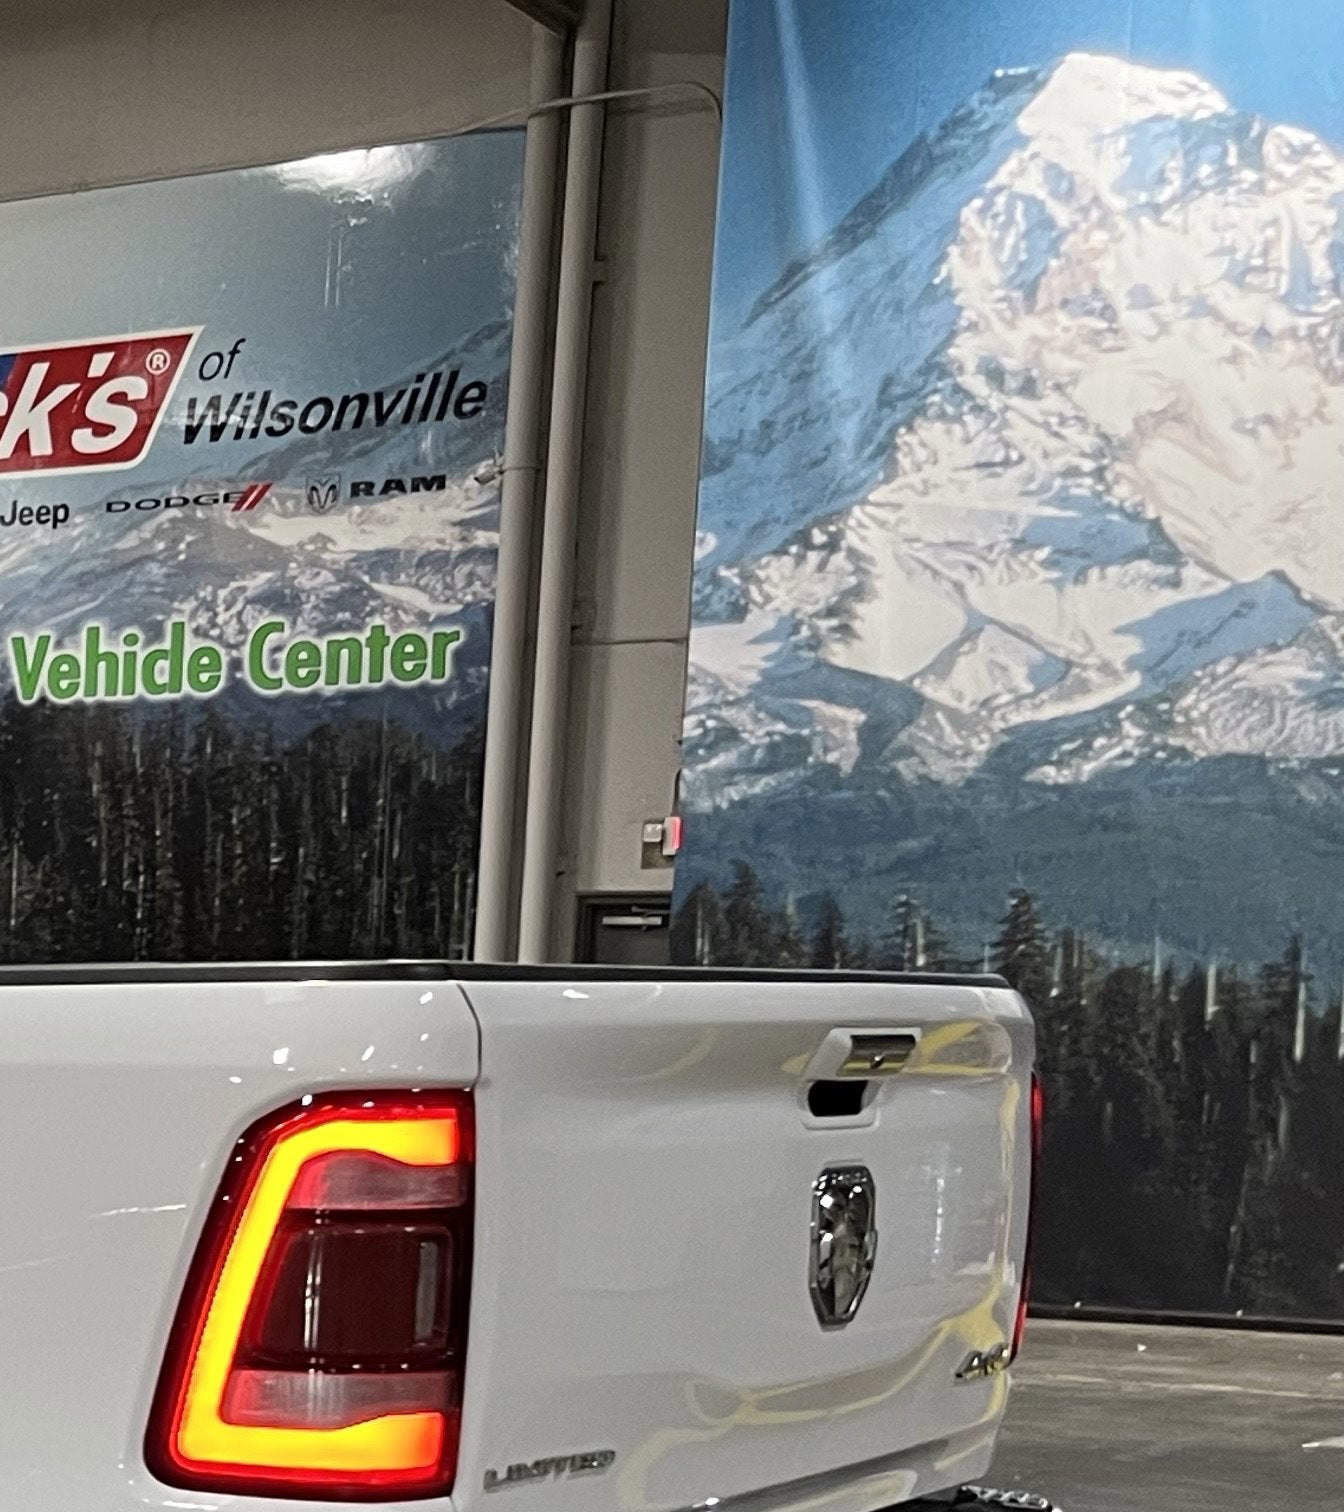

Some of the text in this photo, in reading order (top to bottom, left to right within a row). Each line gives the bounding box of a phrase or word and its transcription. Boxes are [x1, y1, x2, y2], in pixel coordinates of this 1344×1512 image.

[198, 338, 246, 381] of
[182, 370, 488, 445] Wilsonville
[0, 500, 70, 529] Jeep
[349, 474, 447, 499] RAM
[11, 621, 223, 702] Vehicle
[248, 621, 460, 691] Center
